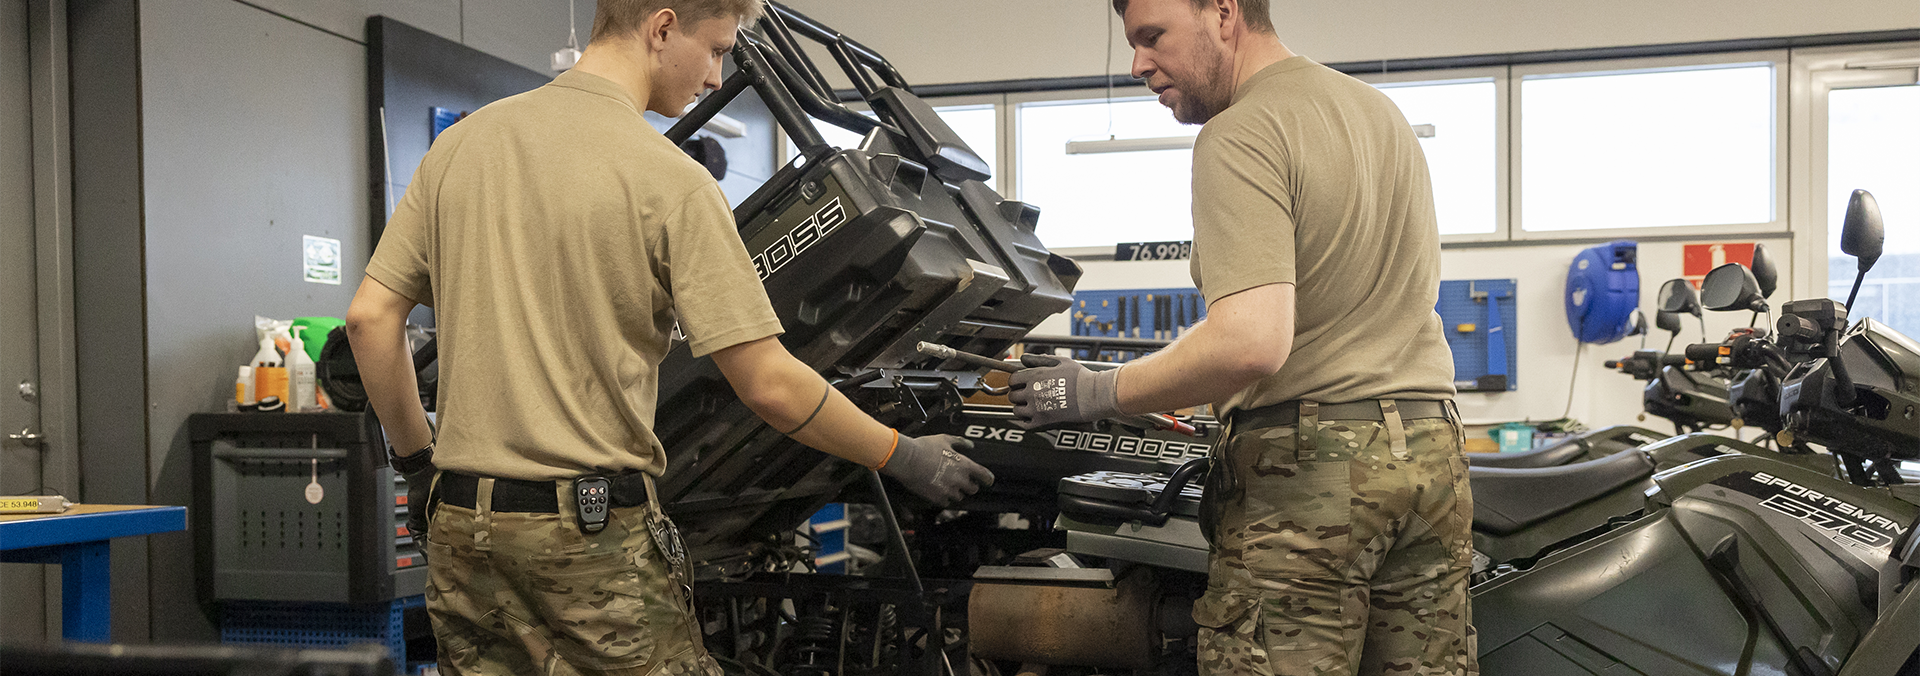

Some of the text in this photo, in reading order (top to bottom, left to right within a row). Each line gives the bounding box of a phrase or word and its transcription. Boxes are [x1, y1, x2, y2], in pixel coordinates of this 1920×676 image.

[1129, 244, 1190, 261] 76.998
[1058, 378, 1068, 409] ODIN
[965, 425, 1026, 442] 6X6
[1055, 430, 1211, 459] BIG BOSS
[1751, 472, 1909, 535] SPORTSMAN
